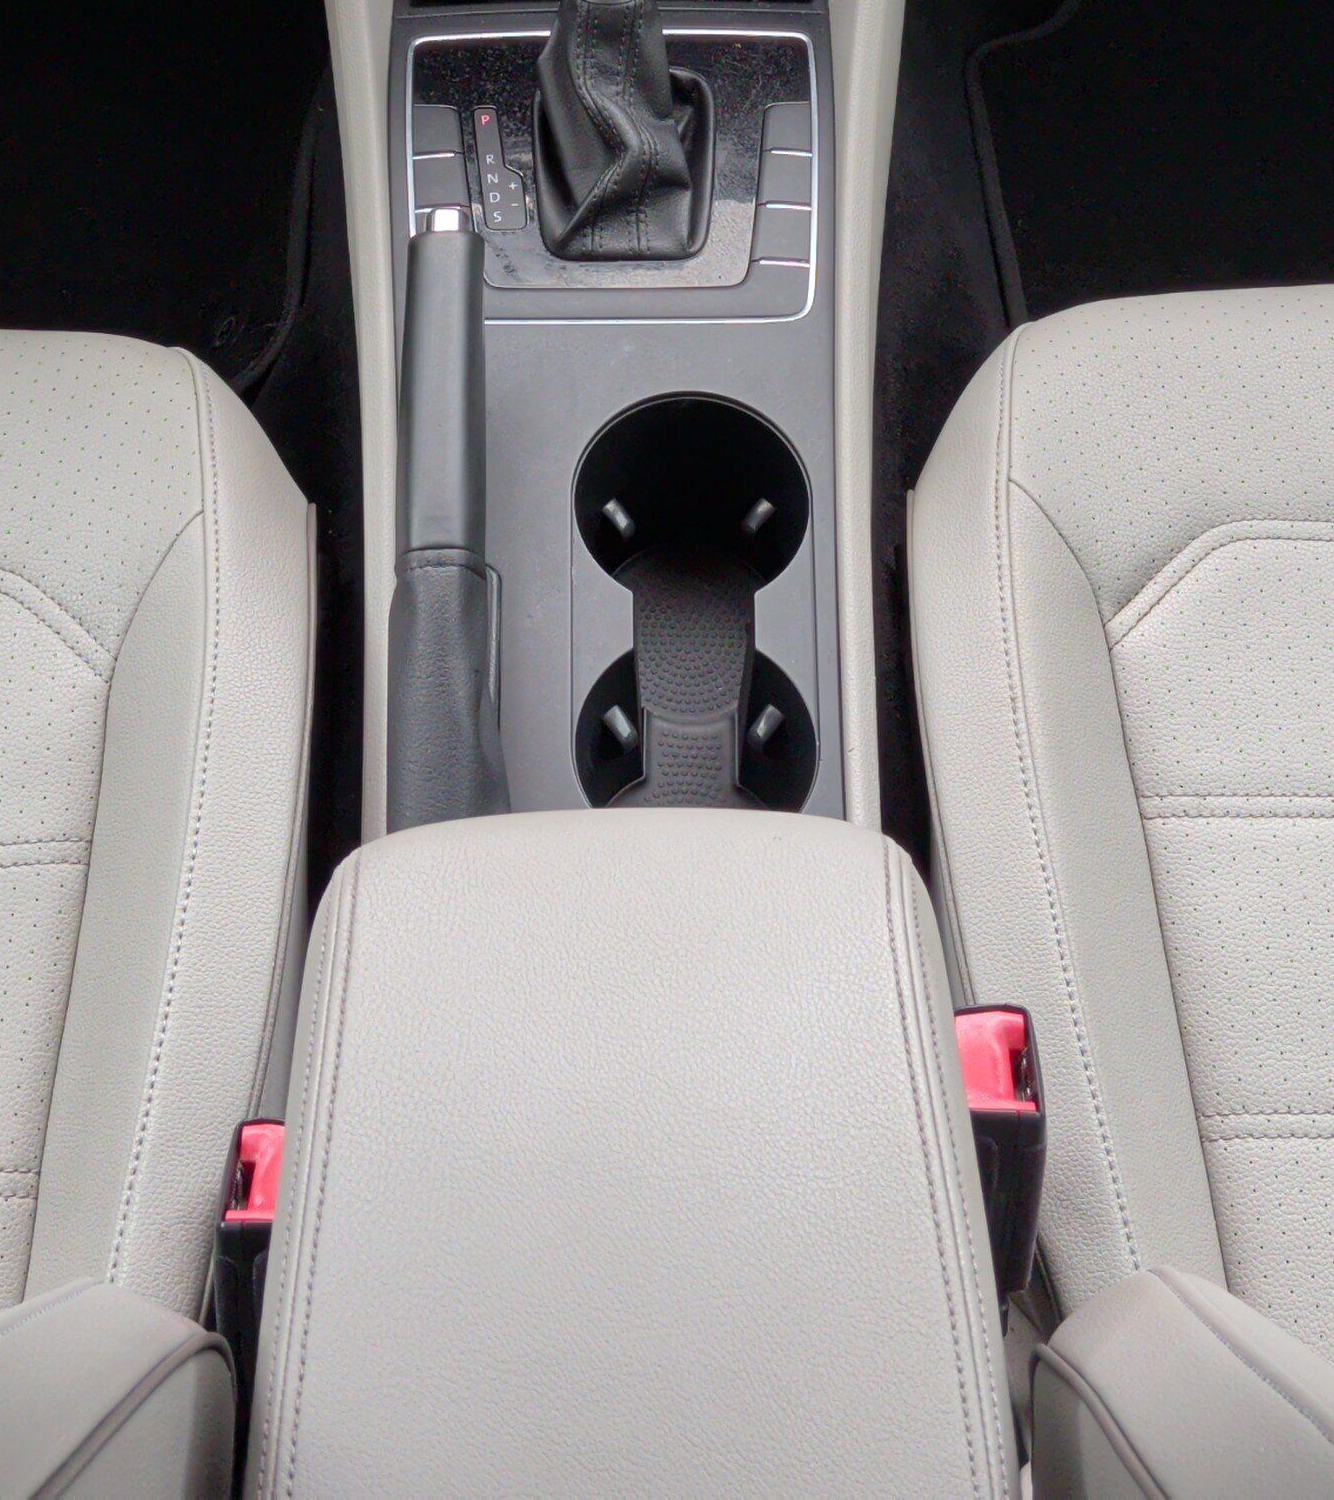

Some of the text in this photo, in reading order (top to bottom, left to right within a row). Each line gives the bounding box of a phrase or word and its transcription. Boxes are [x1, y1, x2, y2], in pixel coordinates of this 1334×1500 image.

[481, 114, 490, 126] P
[486, 154, 495, 165] R
[487, 173, 499, 184] N
[489, 192, 500, 203] D
[493, 210, 503, 223] S
